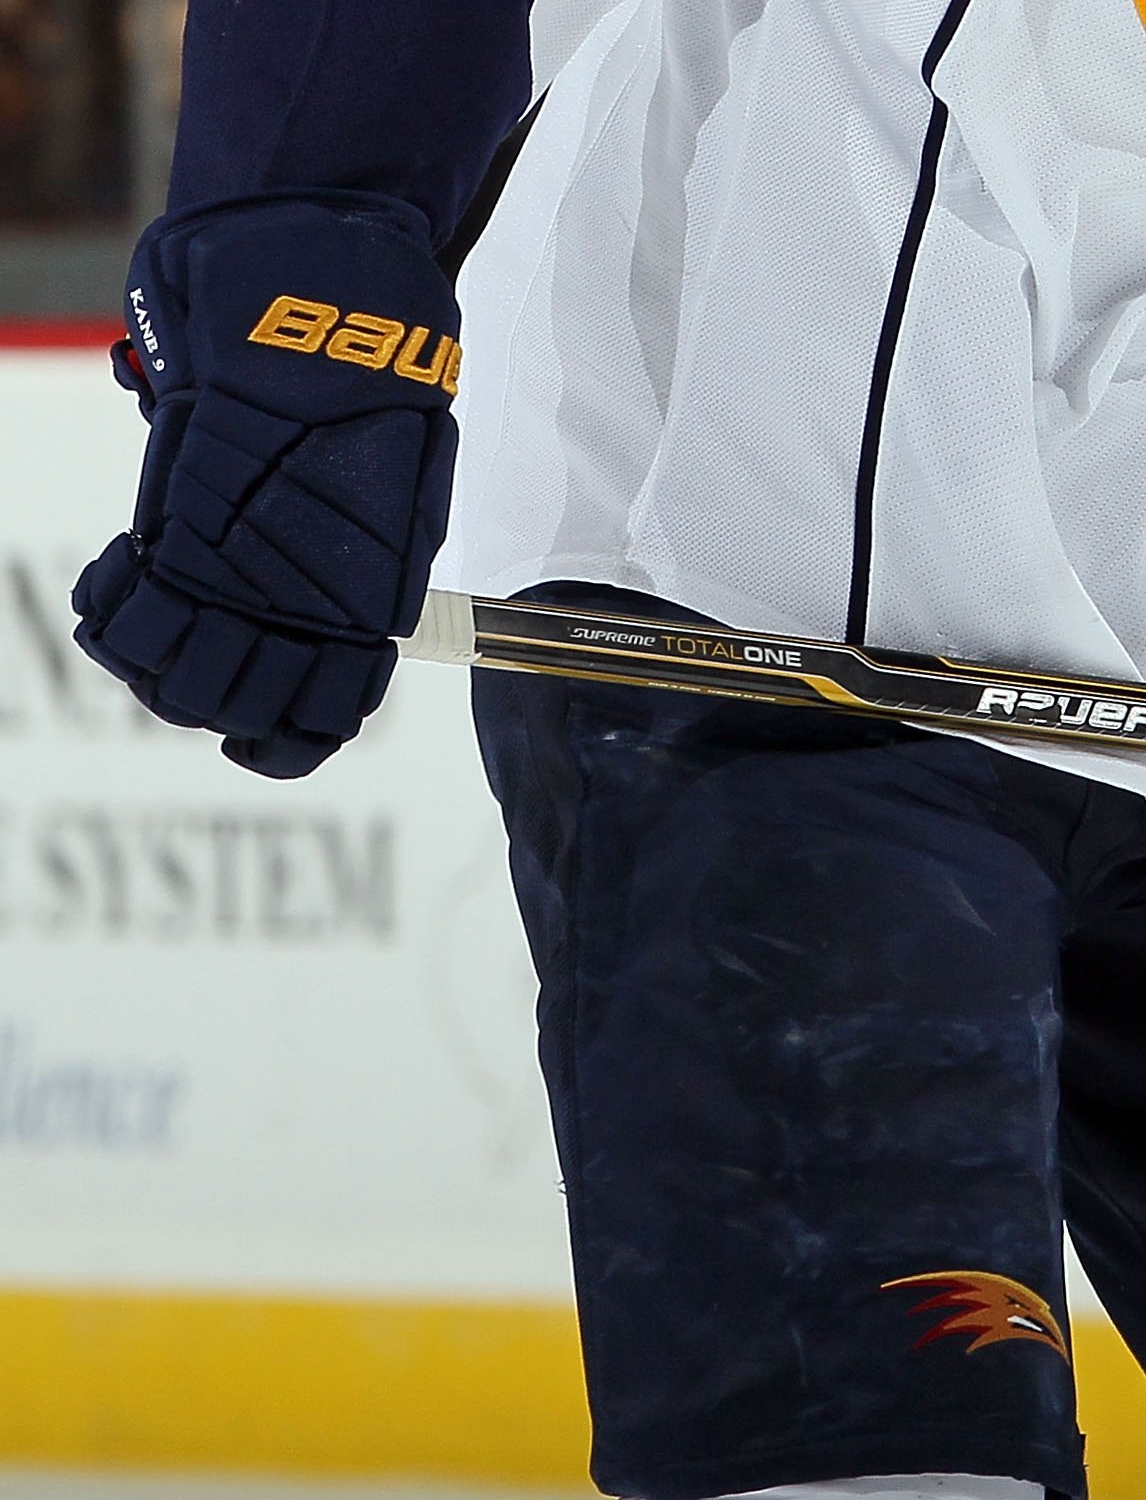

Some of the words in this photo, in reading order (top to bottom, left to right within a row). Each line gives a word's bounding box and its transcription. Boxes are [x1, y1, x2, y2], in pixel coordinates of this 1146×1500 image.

[130, 287, 159, 354] KANE
[151, 358, 165, 372] 9
[33, 805, 398, 943] SYSTEM
